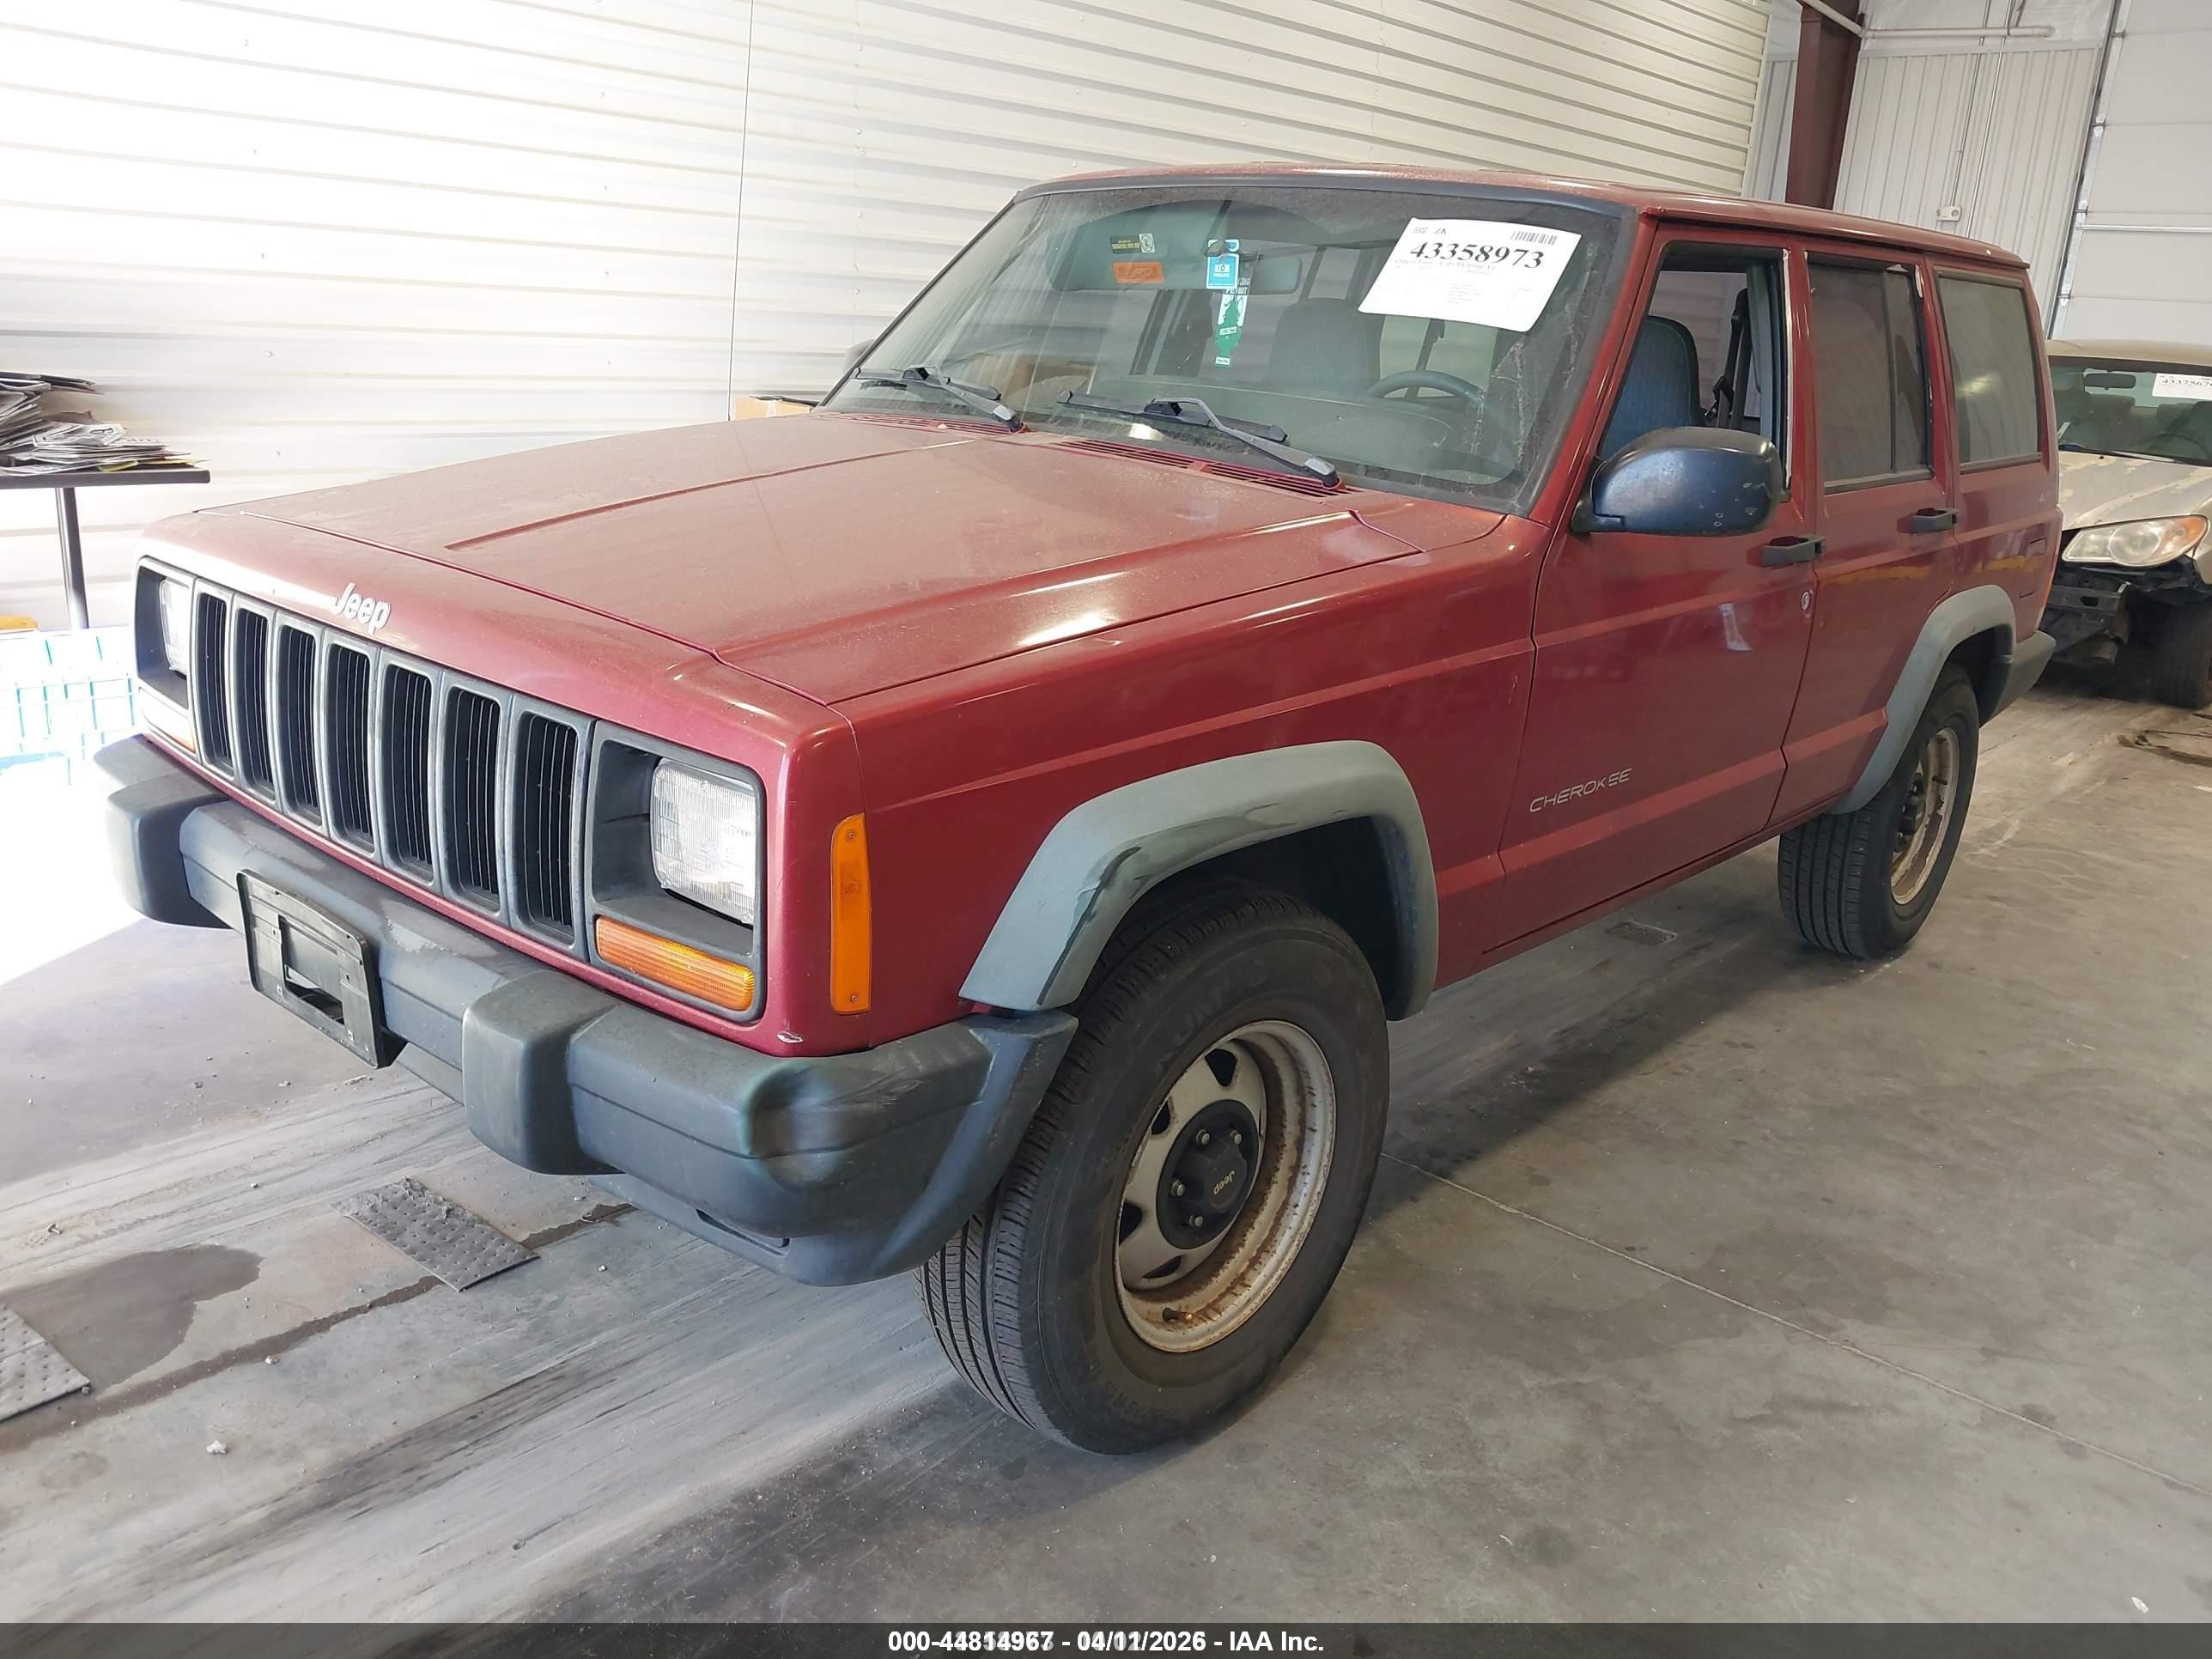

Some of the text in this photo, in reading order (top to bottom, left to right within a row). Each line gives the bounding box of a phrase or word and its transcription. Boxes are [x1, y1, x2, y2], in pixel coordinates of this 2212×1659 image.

[1410, 241, 1544, 269] 43358973
[330, 581, 392, 635] Jeep
[1529, 768, 1632, 812] CHEROKEE
